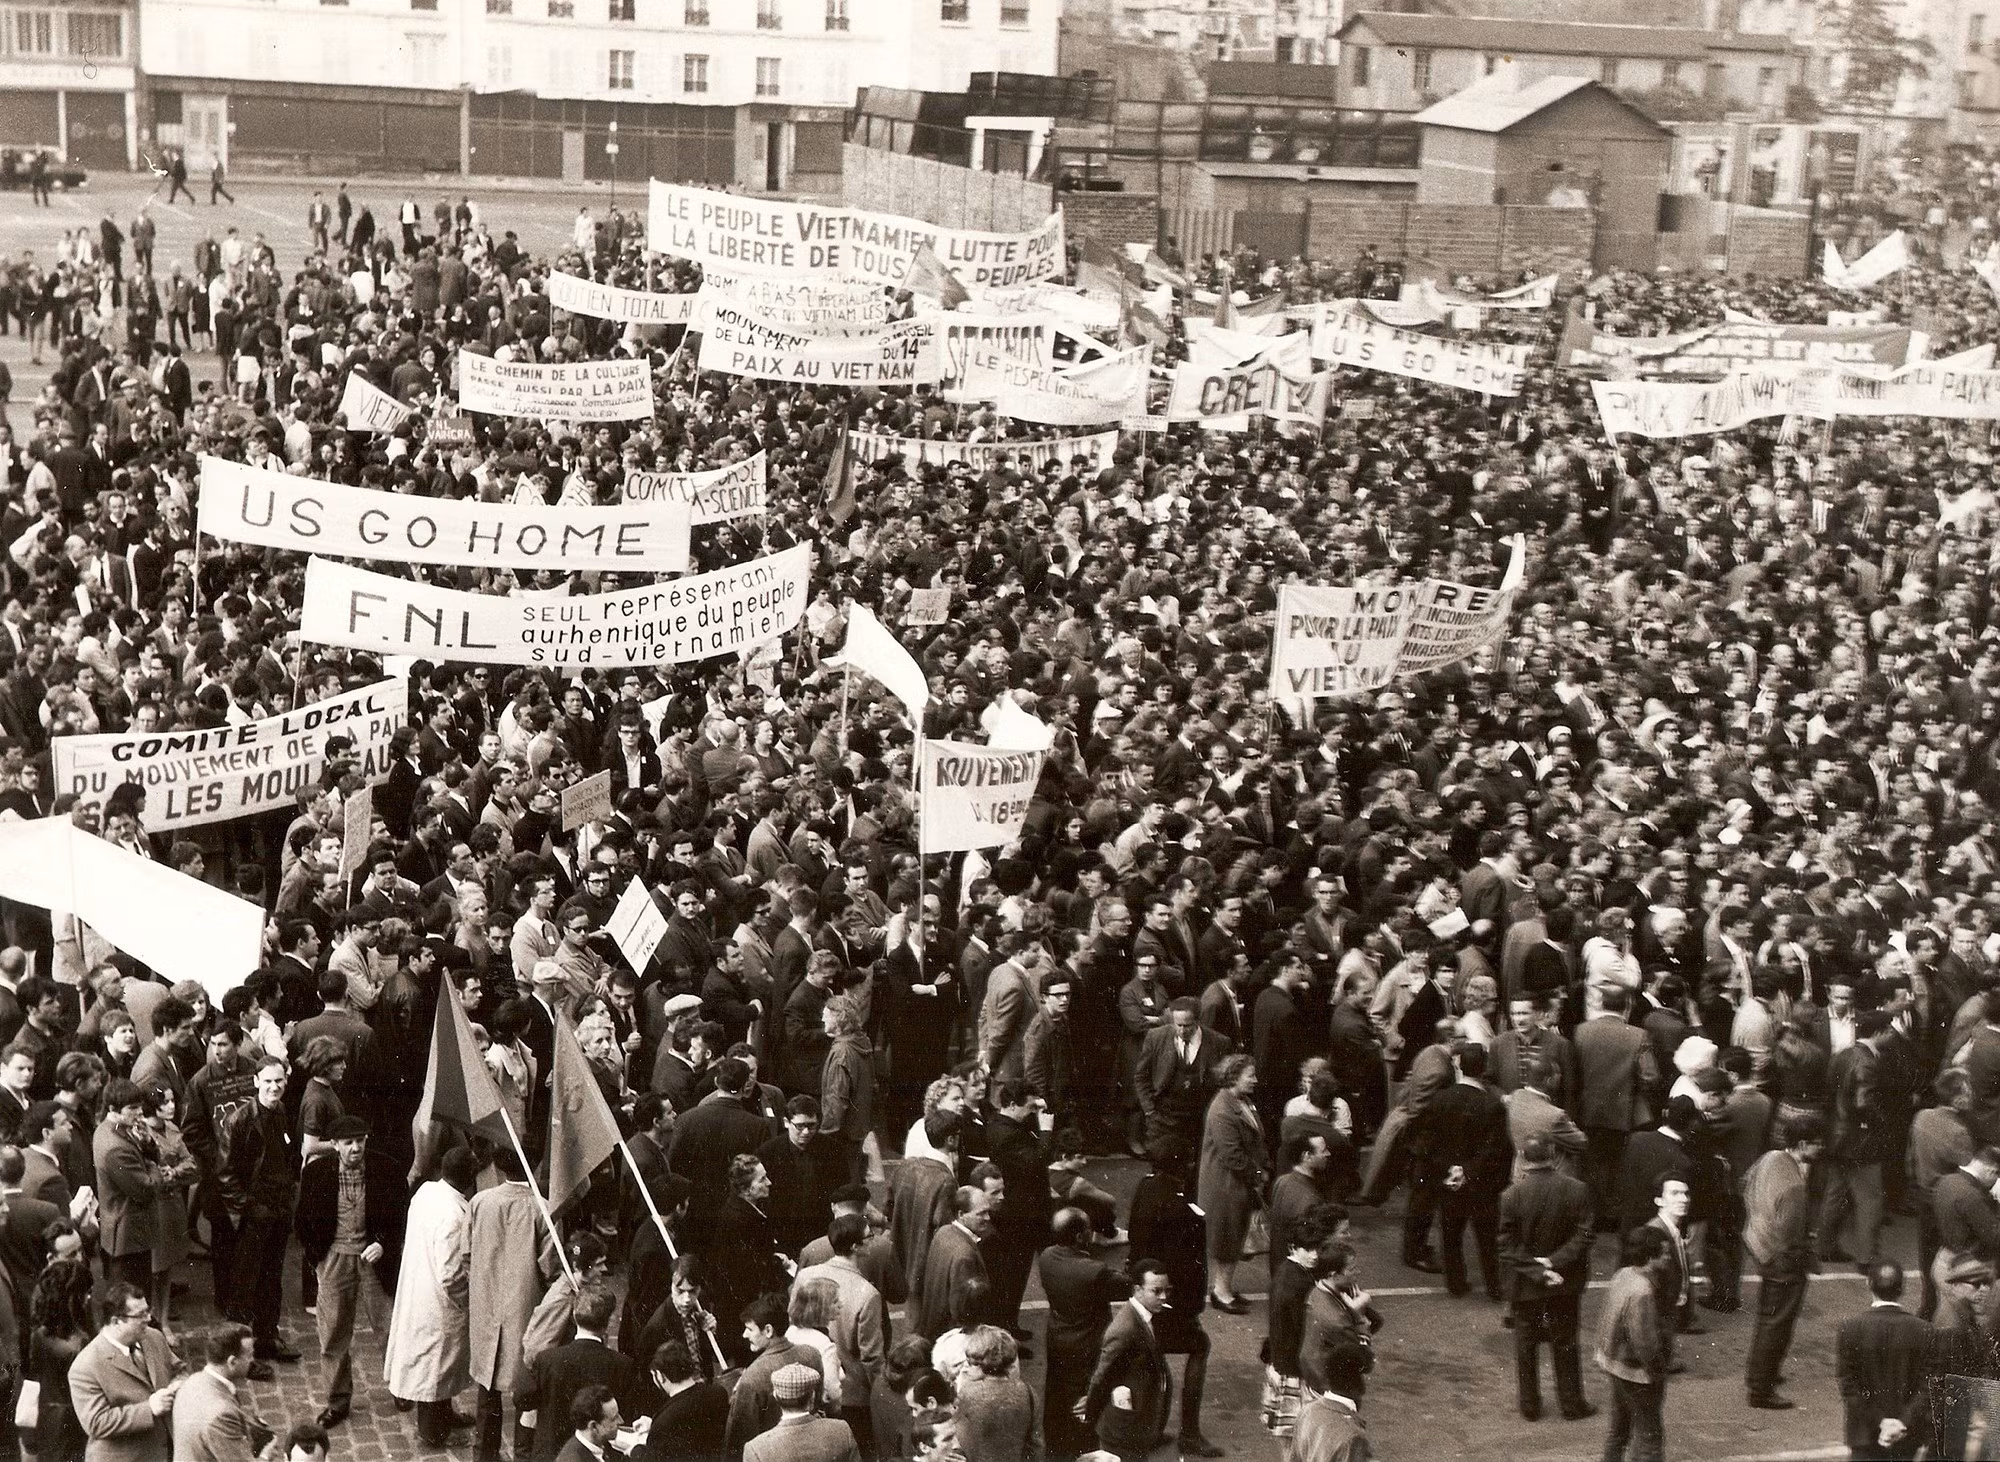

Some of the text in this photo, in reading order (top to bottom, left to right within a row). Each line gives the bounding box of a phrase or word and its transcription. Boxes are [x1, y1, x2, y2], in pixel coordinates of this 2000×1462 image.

[668, 193, 1060, 263] LE PEUPLE VIETNAMIEN LUTTE POUR
[673, 225, 697, 251] LA
[809, 245, 840, 268] DE
[852, 245, 905, 280] TOUS
[976, 253, 1055, 288] PEUPLES
[622, 296, 669, 319] TOTAL
[716, 307, 812, 347] MOUVEMENT
[716, 327, 732, 342] DE
[738, 333, 755, 346] LA
[471, 360, 641, 381] LE CHEMIN DE LA CULTURE
[732, 351, 915, 380] PAIX AU VIET NAM
[883, 348, 898, 360] DU
[974, 351, 999, 370] LE
[1332, 336, 1375, 361] US
[1402, 350, 1434, 373] GO
[470, 375, 504, 388] PASSE
[515, 384, 552, 395] AUSSI
[560, 387, 583, 396] PAR
[593, 383, 614, 396] LA
[619, 377, 646, 394] PAIX
[360, 385, 410, 431] VIETN
[241, 485, 650, 558] US GO HOME
[523, 606, 591, 623] SEUL
[697, 604, 723, 627] du
[732, 579, 795, 627] peuple
[280, 694, 387, 737] LOCAL
[73, 771, 107, 795] DU
[125, 745, 274, 786] MOUVEMENT
[287, 735, 317, 760] DE
[370, 714, 404, 742] PAI
[165, 781, 224, 820] LES
